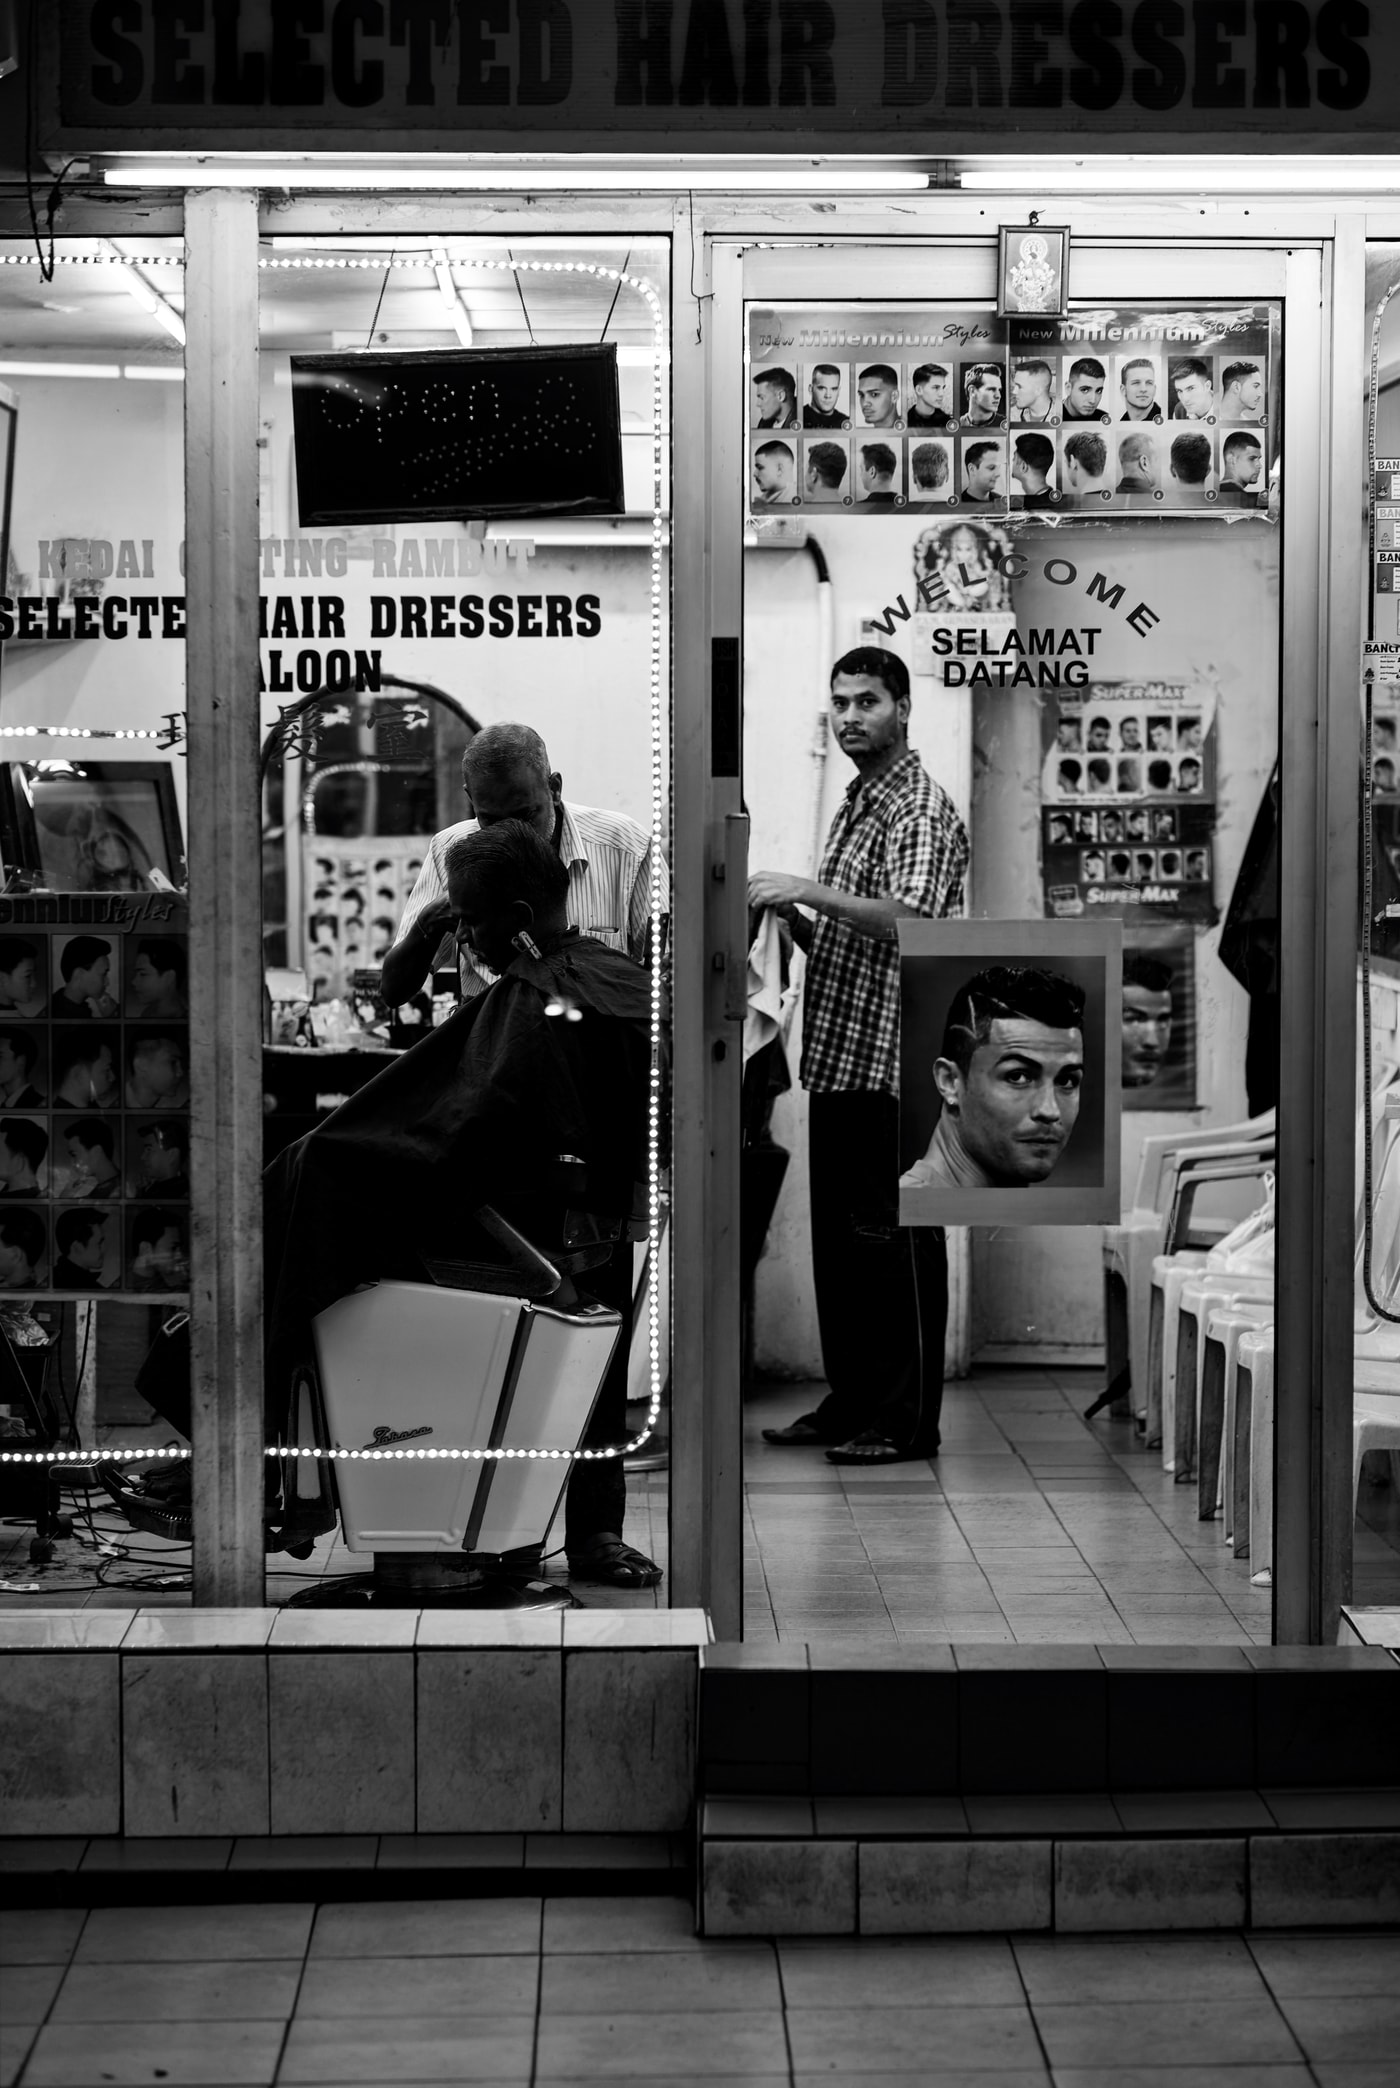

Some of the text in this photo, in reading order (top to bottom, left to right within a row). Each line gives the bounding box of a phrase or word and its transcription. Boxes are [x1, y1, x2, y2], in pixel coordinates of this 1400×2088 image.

[90, 0, 1371, 111] SELECTED HAIR DRESSERS
[759, 323, 992, 348] New Millennium Styles
[1019, 319, 1250, 342] New Millennium Styles
[38, 537, 536, 579] KEDAI TING RAMBUT
[869, 553, 1161, 638] WELCOME
[0, 594, 602, 641] SELECTE AIR DRESSERS
[931, 628, 1102, 656] SELAMAT
[259, 648, 382, 693] LOON
[943, 660, 1090, 688] DATANG
[101, 892, 175, 934] Styles
